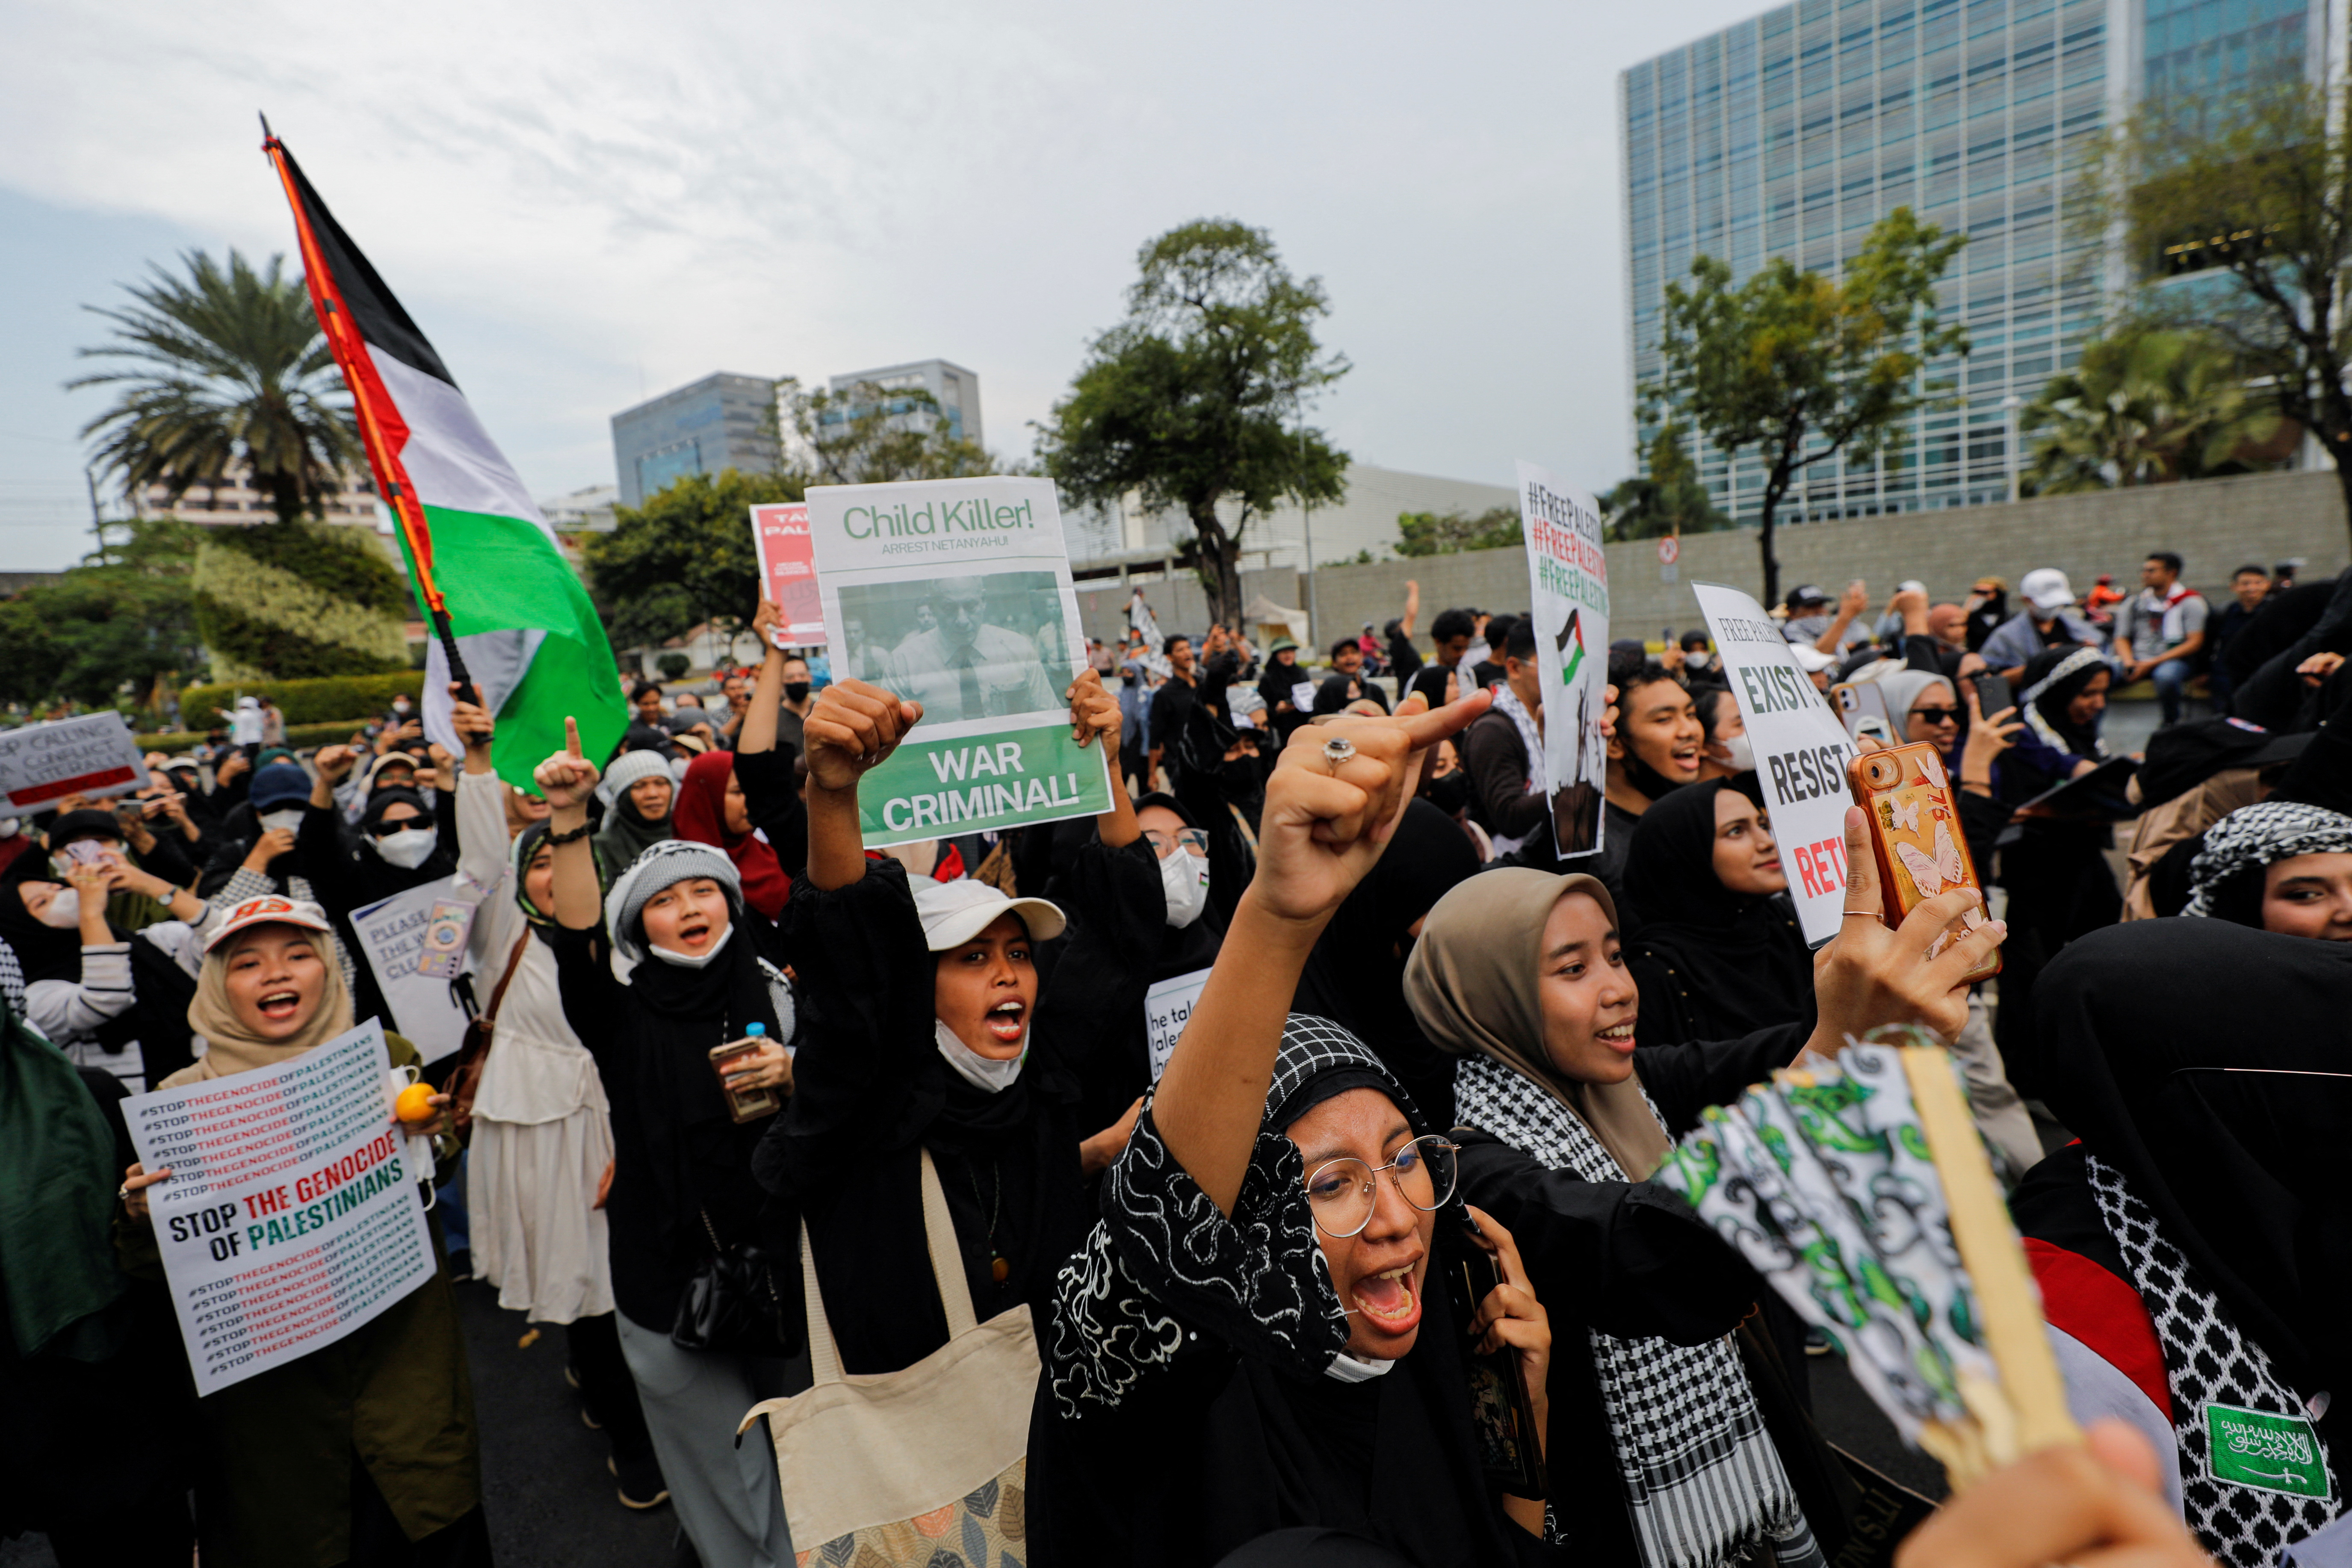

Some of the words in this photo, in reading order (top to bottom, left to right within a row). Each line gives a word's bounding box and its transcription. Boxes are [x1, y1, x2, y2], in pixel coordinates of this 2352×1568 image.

[764, 525, 810, 537] PAL
[843, 502, 936, 539] Child
[941, 498, 1034, 533] Killer!
[882, 540, 929, 555] ARREST
[931, 535, 1009, 552] NETANYAHU!
[1718, 618, 1753, 641] FREE
[23, 738, 115, 769] CONFLICT
[29, 723, 113, 750] CALLING
[928, 742, 1025, 783] WAR
[883, 773, 1080, 832] CRIMINAL!
[369, 909, 427, 942] PLEASE
[378, 939, 408, 960] THE
[1171, 1000, 1195, 1023] tal
[140, 1034, 372, 1118] #STOPTHEGENOCIDEOFPALESTINIANS
[144, 1047, 375, 1132] #STOPTHEGENOCIDEOFPALESTINIANS
[148, 1060, 377, 1145] #STOPTHEGENOCIDEOFPALESTINIANS
[153, 1072, 380, 1158] #STOPTHEGENOCIDEOFPALESTINIANS
[163, 1110, 388, 1202] #STOPTHEGENOCIDEOFPALESTINIANS
[169, 1202, 237, 1243] STOP
[243, 1184, 292, 1220] THE
[295, 1129, 397, 1204] GENOCIDE
[188, 1193, 408, 1298] #STOPTHEGENOCIDEOFPALESTINIANS
[209, 1231, 242, 1262] OF
[247, 1158, 403, 1251] PALESTINIANS
[192, 1205, 411, 1311] #STOPTHEGENOCIDEOFPALESTINIANS
[195, 1217, 414, 1324] #STOPTHEGENOCIDEOFPALESTINIANS
[199, 1228, 417, 1337] #STOPTHEGENOCIDEOFPALESTINIANS
[203, 1239, 420, 1350] #STOPTHEGENOCIDEOFPALESTINIANS
[206, 1251, 423, 1363] #STOPTHEGENOCIDEOFPALESTINIANS
[210, 1262, 425, 1376] #STOPTHEGENOCIDEOFPALESTINIANS
